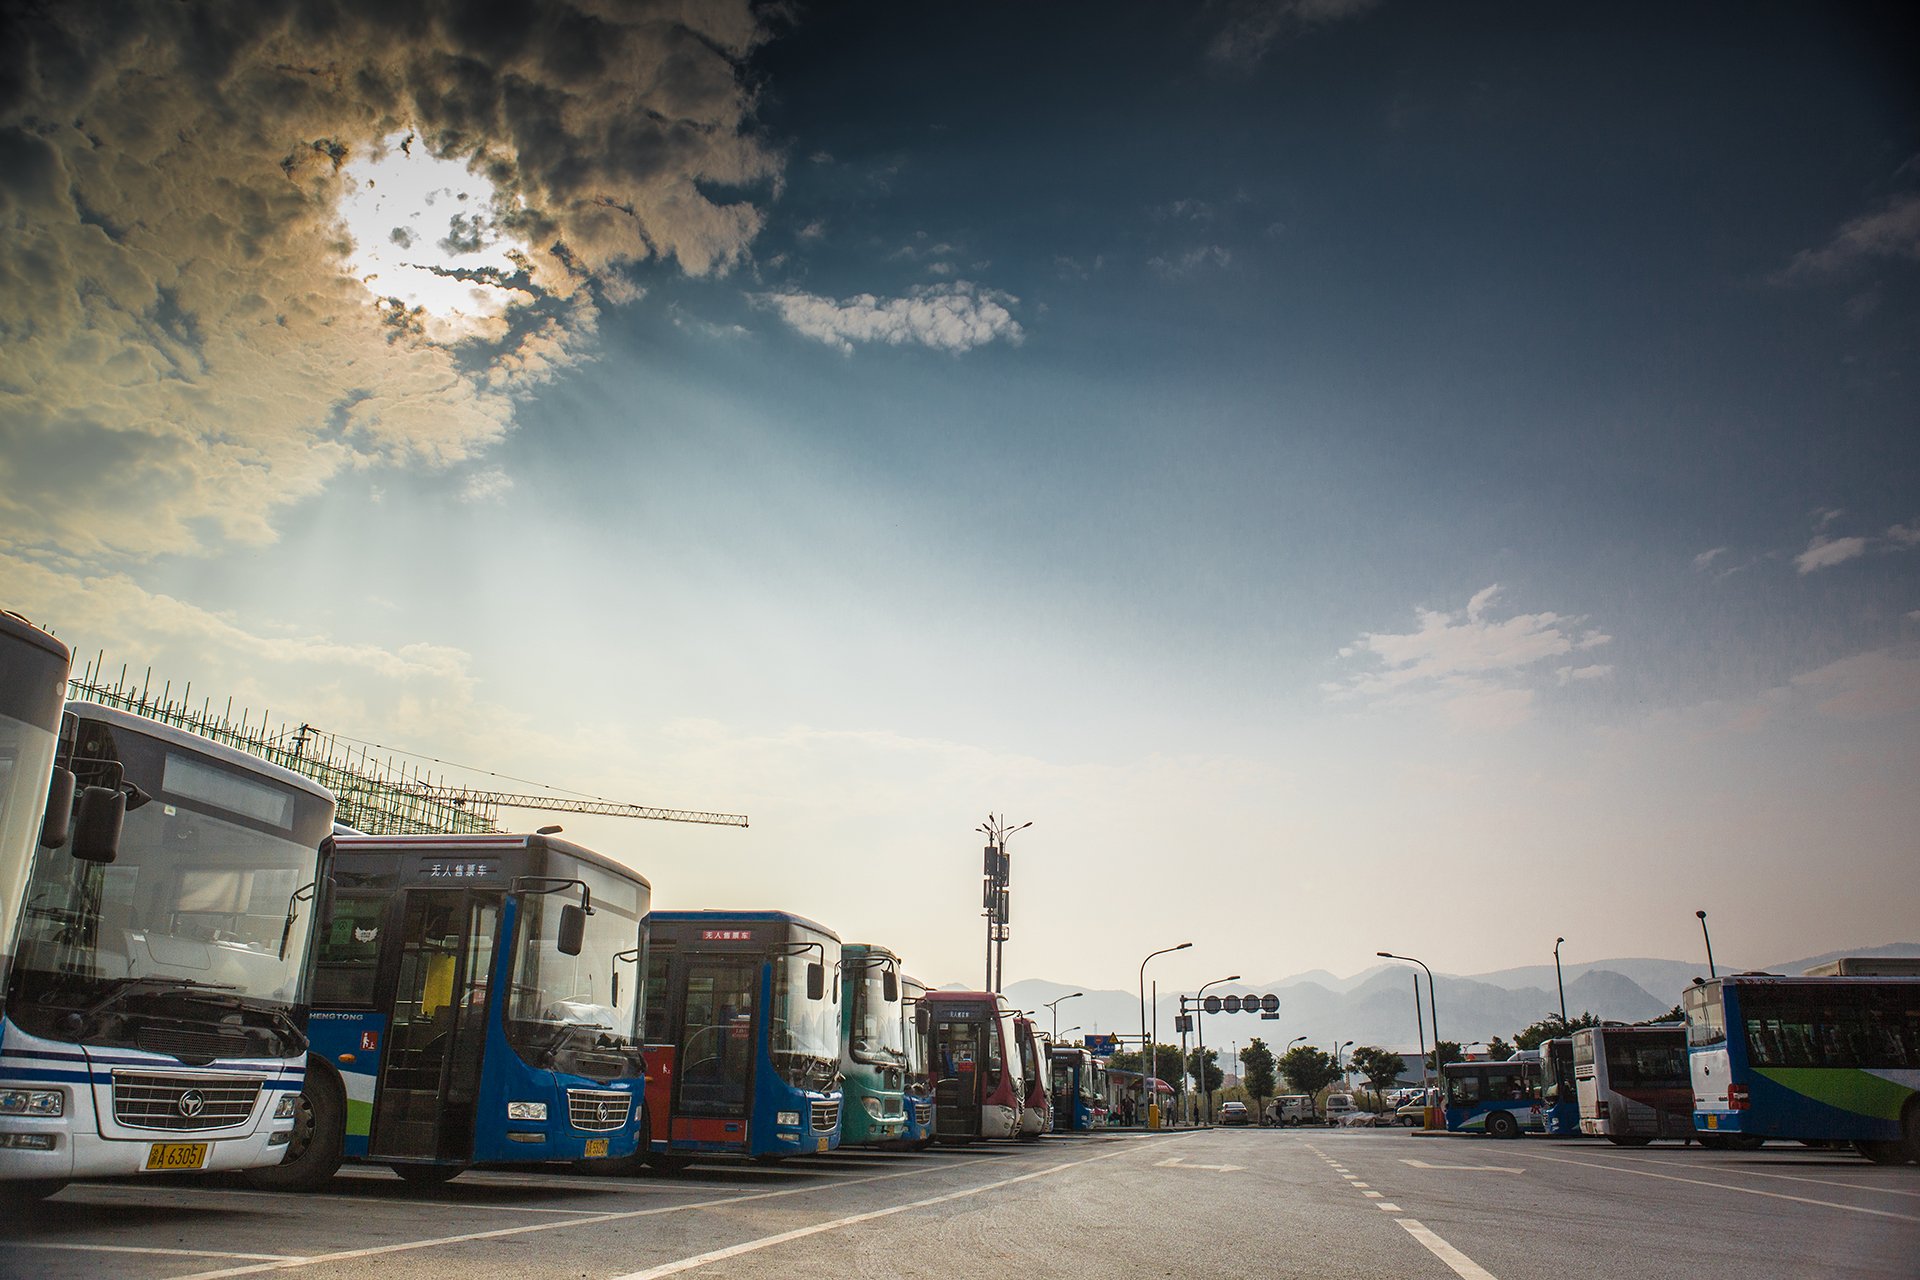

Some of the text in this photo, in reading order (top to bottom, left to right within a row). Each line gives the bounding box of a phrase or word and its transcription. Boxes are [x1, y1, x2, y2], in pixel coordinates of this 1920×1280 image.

[431, 864, 487, 877] 无人售票车
[309, 1012, 363, 1020] HENGTONG
